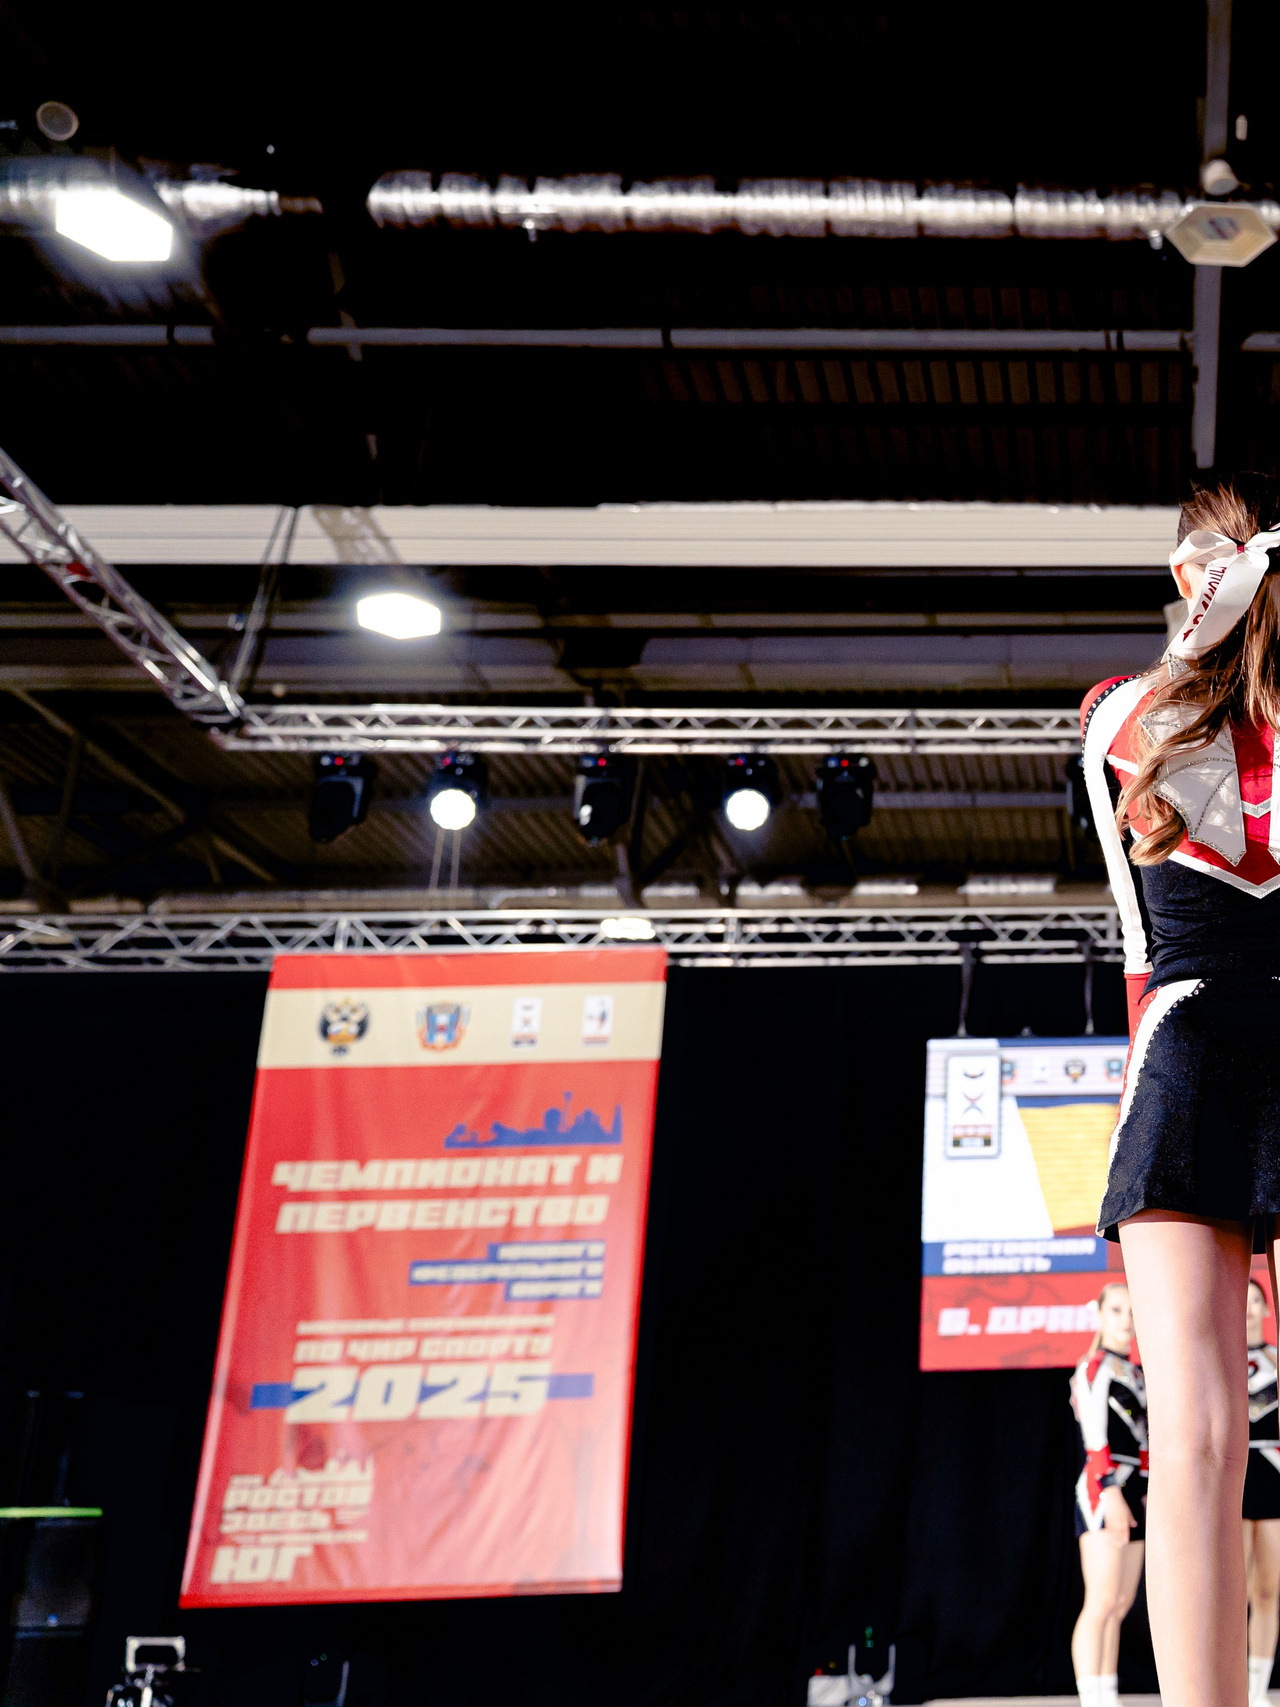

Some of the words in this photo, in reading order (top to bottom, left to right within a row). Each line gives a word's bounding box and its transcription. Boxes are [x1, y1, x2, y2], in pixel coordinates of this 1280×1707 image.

[271, 1155, 581, 1193] ЧЕМПИОНАТ
[586, 1154, 623, 1185] И
[276, 1195, 611, 1235] ПЕРВЕНСТВО
[294, 1339, 345, 1364] ПО
[419, 1335, 550, 1360] СПОРТУ
[286, 1362, 551, 1423] 2025
[211, 1546, 312, 1583] ЮГ
